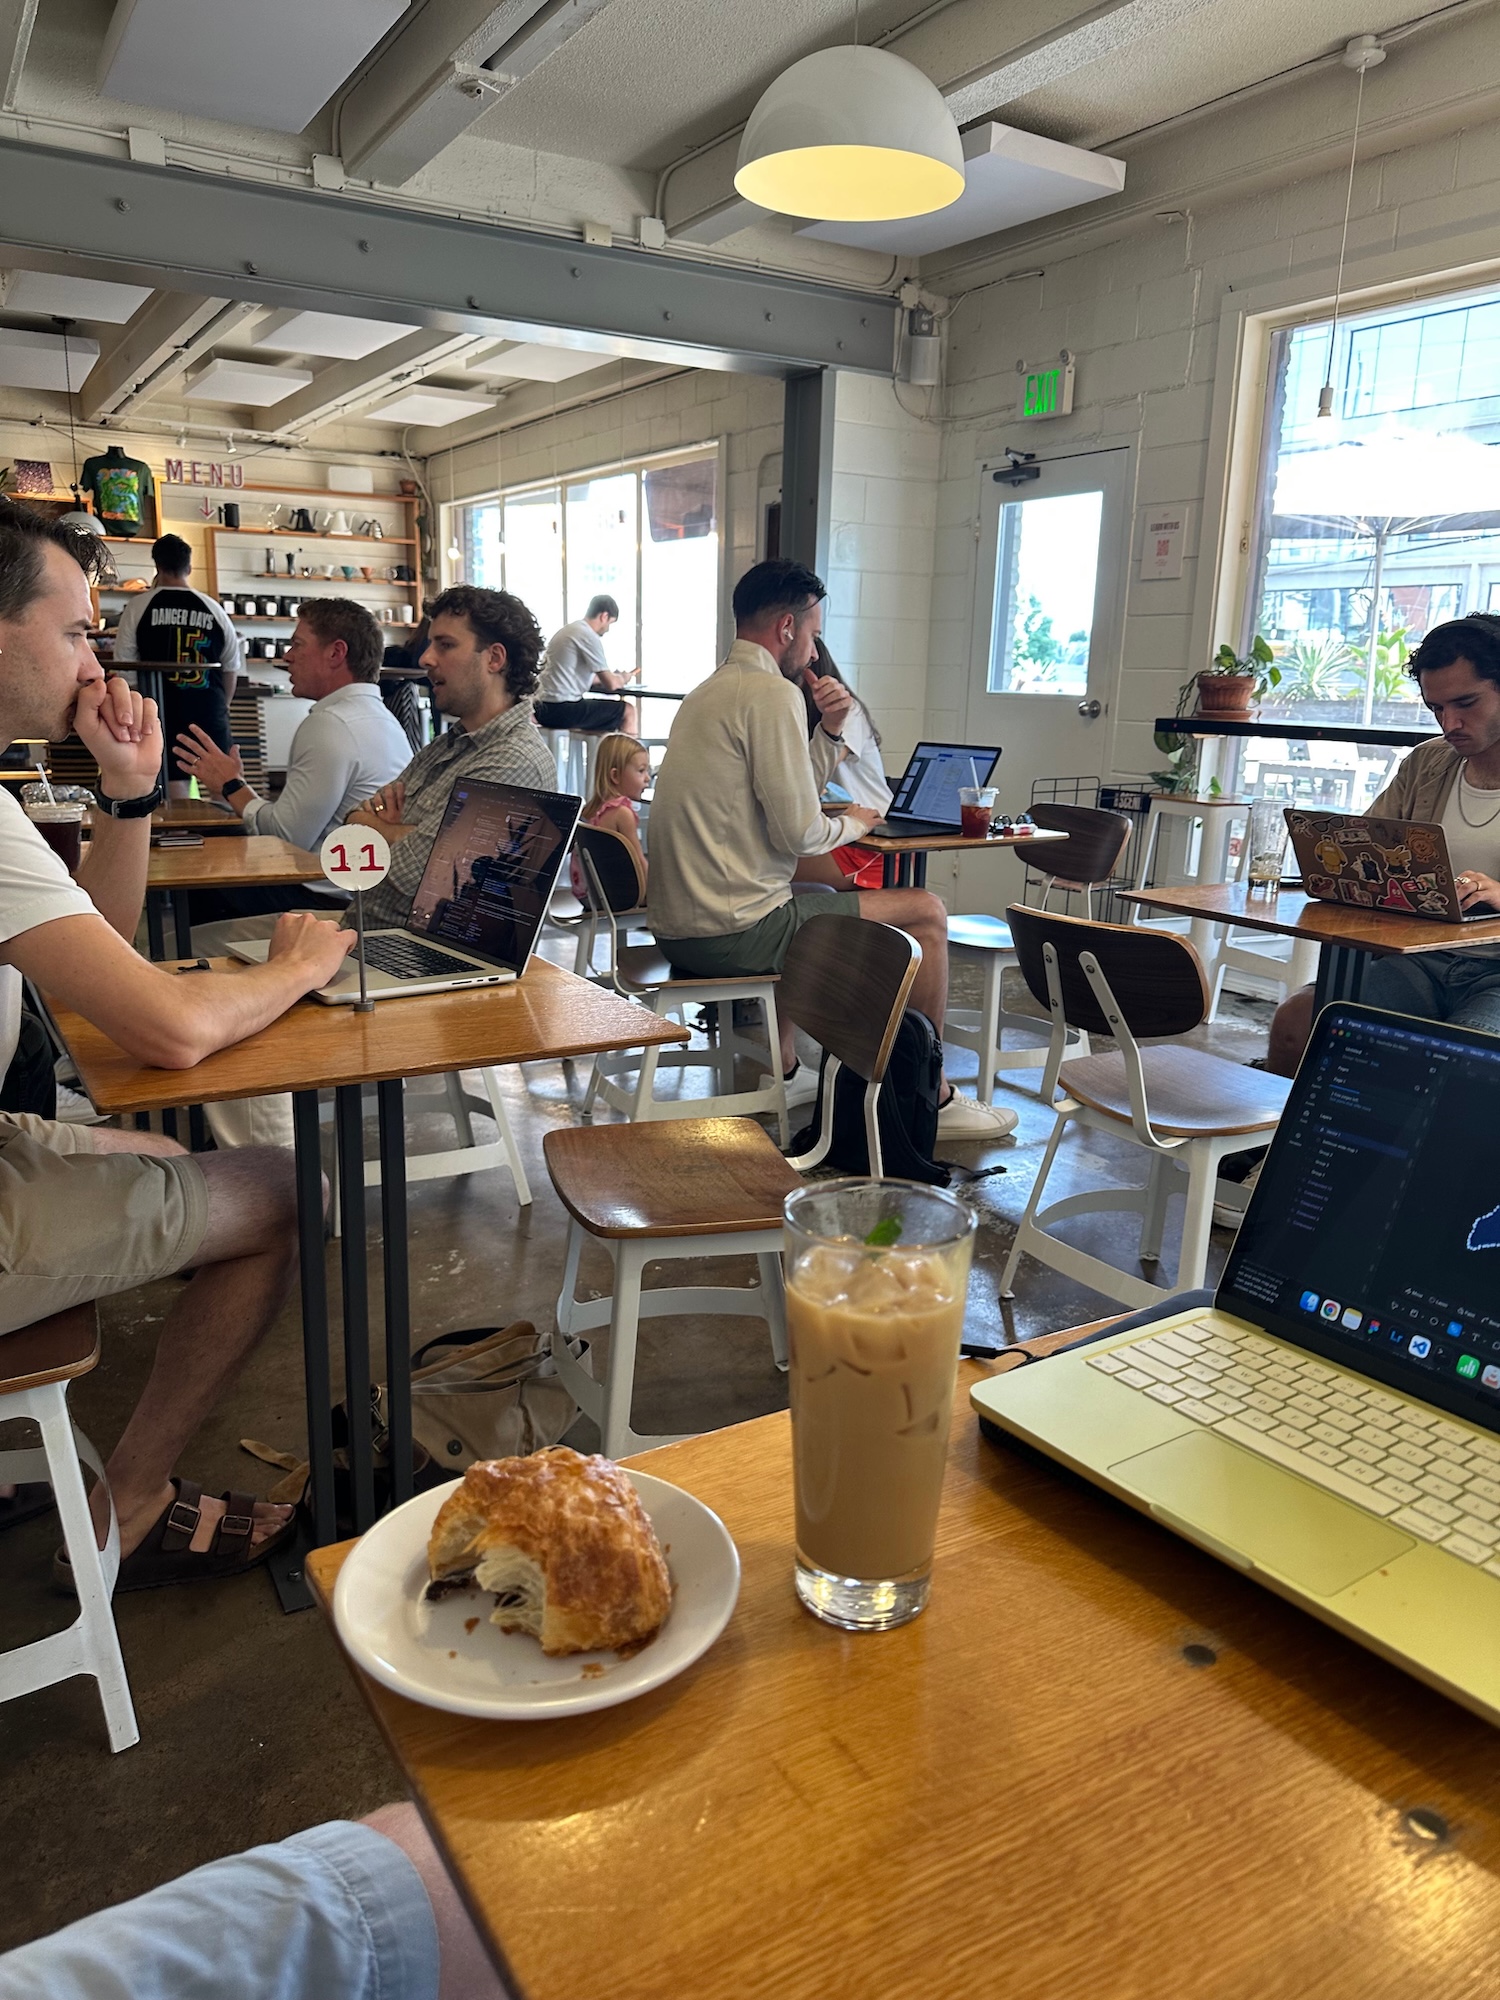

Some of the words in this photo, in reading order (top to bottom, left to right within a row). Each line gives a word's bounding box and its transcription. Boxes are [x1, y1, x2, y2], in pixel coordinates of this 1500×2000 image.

[1024, 370, 1060, 416] EXIT
[165, 458, 244, 488] MENU
[151, 607, 188, 626] DANGER
[189, 610, 214, 630] DAYS
[330, 844, 384, 872] 11
